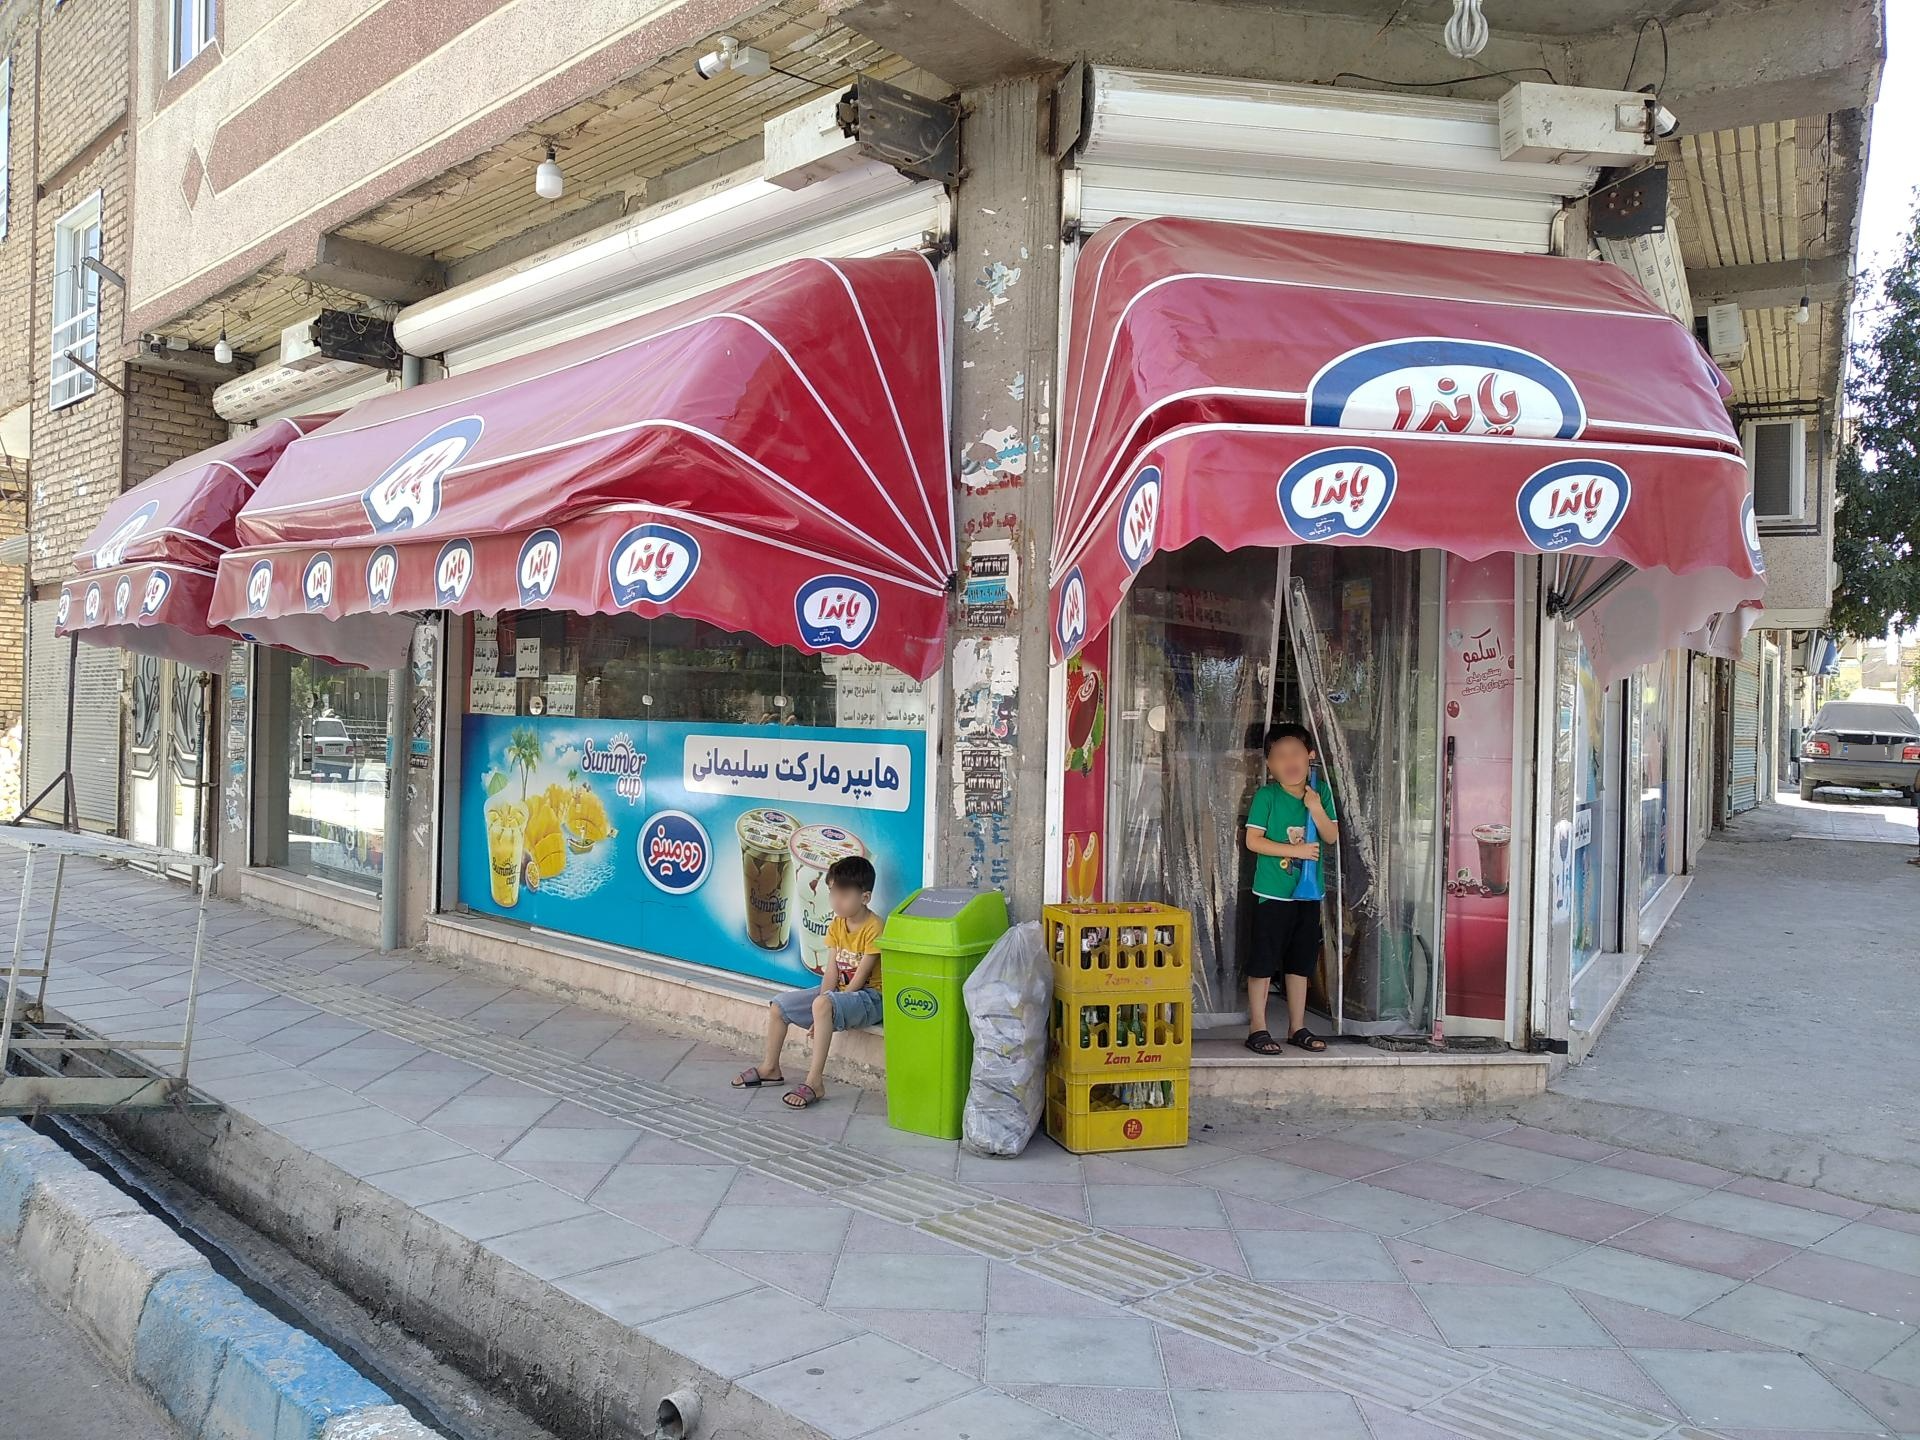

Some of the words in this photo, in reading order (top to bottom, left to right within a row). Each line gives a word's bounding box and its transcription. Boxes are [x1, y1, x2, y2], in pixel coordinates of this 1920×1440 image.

[1393, 372, 1522, 436] پاندا
[1311, 465, 1370, 512] پاندا
[1549, 477, 1604, 524] پاندا
[1129, 487, 1154, 549] پاندا
[374, 556, 390, 589] پاندا
[444, 549, 465, 586] پاندا
[528, 544, 551, 582] پاندا
[628, 542, 675, 581] پاندا
[313, 565, 328, 591] پاندا
[818, 593, 861, 629] پاندا
[863, 662, 881, 676] موجود
[841, 684, 854, 698] سرد
[854, 682, 876, 698] ساندویچ
[890, 681, 906, 694] لقمه
[843, 709, 856, 721] است
[856, 712, 875, 725] موجود
[886, 709, 902, 721] است
[903, 712, 925, 725] موجود
[582, 736, 647, 775] Summer
[691, 747, 770, 787] سلیمانی
[775, 752, 841, 792] مارکت
[841, 756, 900, 801] هایپر
[615, 776, 643, 806] cup
[648, 824, 703, 876] دومینو
[493, 856, 517, 877] Summer
[750, 887, 789, 914] Summer
[771, 911, 786, 926] cup
[904, 994, 934, 1011] دومینو
[1104, 1051, 1131, 1065] Zam
[1135, 1050, 1162, 1064] Zam
